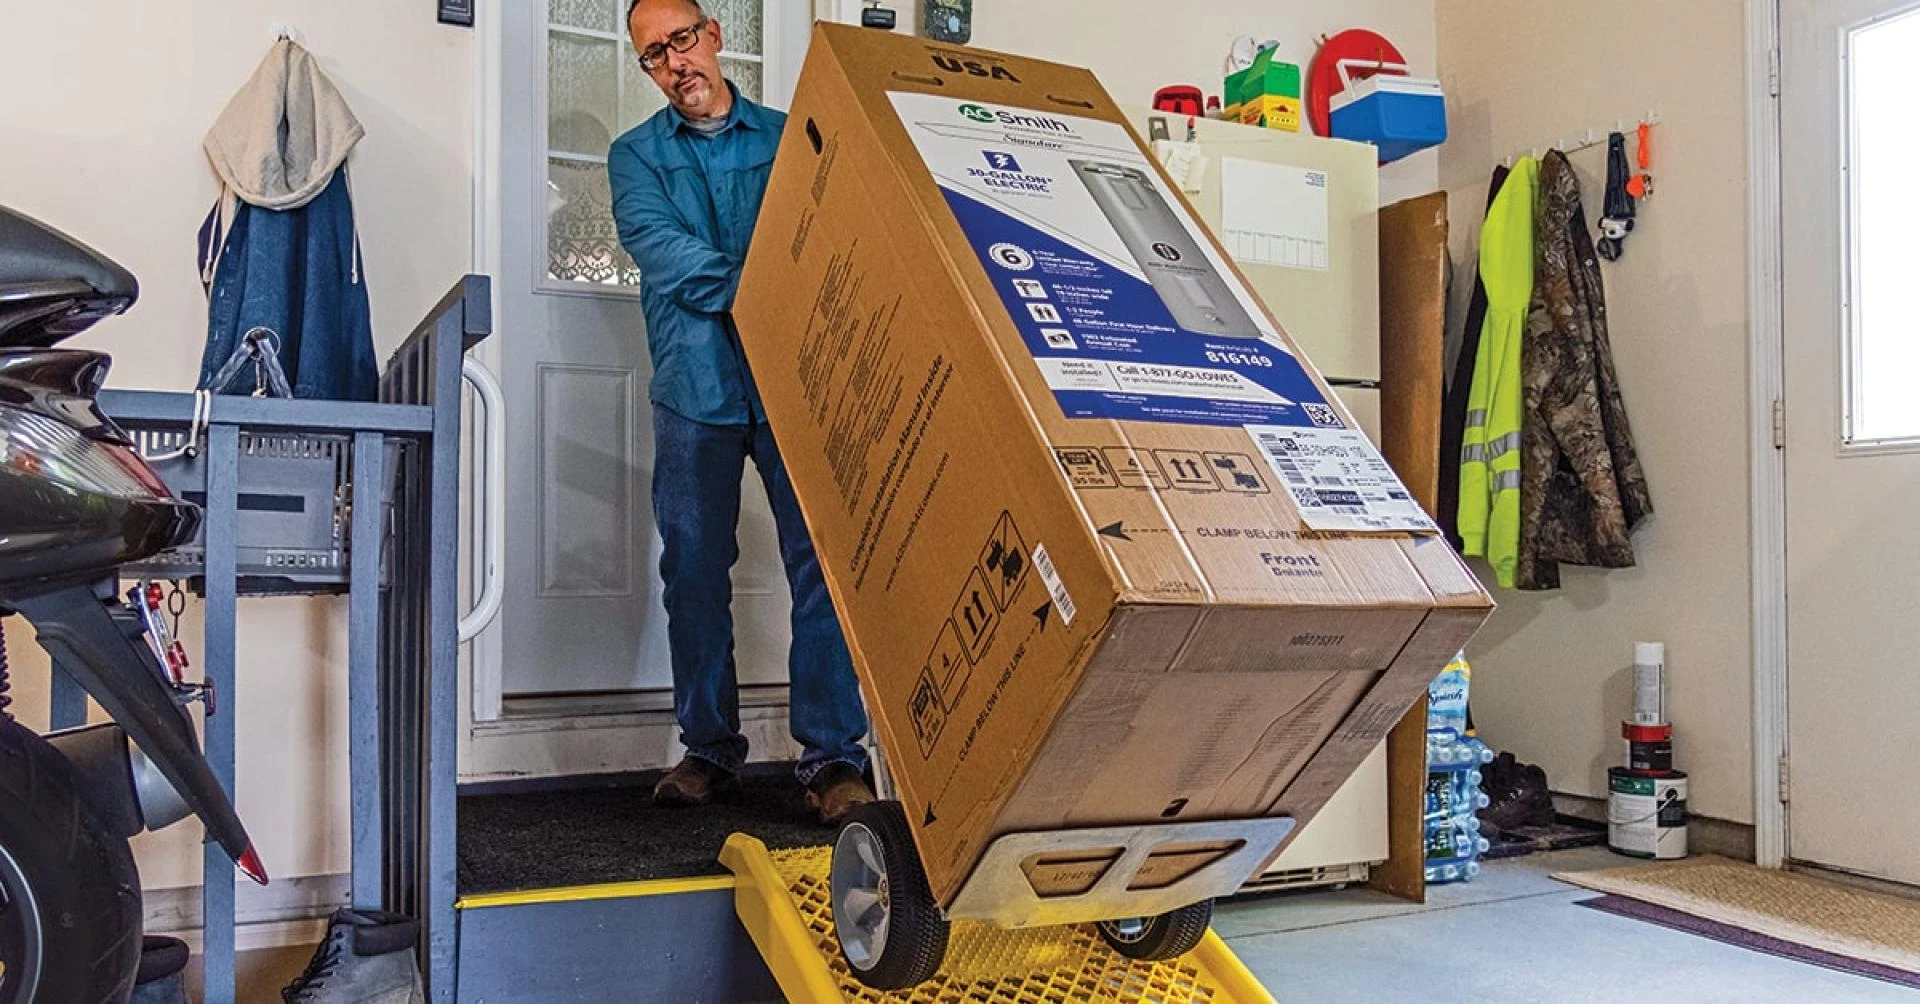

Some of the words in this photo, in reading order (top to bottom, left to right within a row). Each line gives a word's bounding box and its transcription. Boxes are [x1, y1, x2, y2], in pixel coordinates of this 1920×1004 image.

[931, 55, 1022, 83] USA
[984, 179, 1050, 193] ELECTRIC
[1001, 249, 1021, 264] 6
[1205, 351, 1273, 367] 816149
[1116, 365, 1139, 376] Call
[895, 435, 921, 489] completo
[929, 362, 953, 409] interior
[850, 516, 873, 573] Complete
[870, 448, 901, 517] Installation
[898, 393, 924, 450] Manual
[919, 353, 943, 400] Inside
[1197, 527, 1241, 539] CLAMP
[1245, 528, 1291, 540] BELOW
[1295, 530, 1321, 542] THIS
[1322, 530, 1352, 542] LINE
[1259, 552, 1321, 567] Front
[958, 726, 977, 762] CLAMP
[975, 690, 998, 730] BELOW
[996, 666, 1013, 692] THIS
[1008, 642, 1026, 671] LINE
